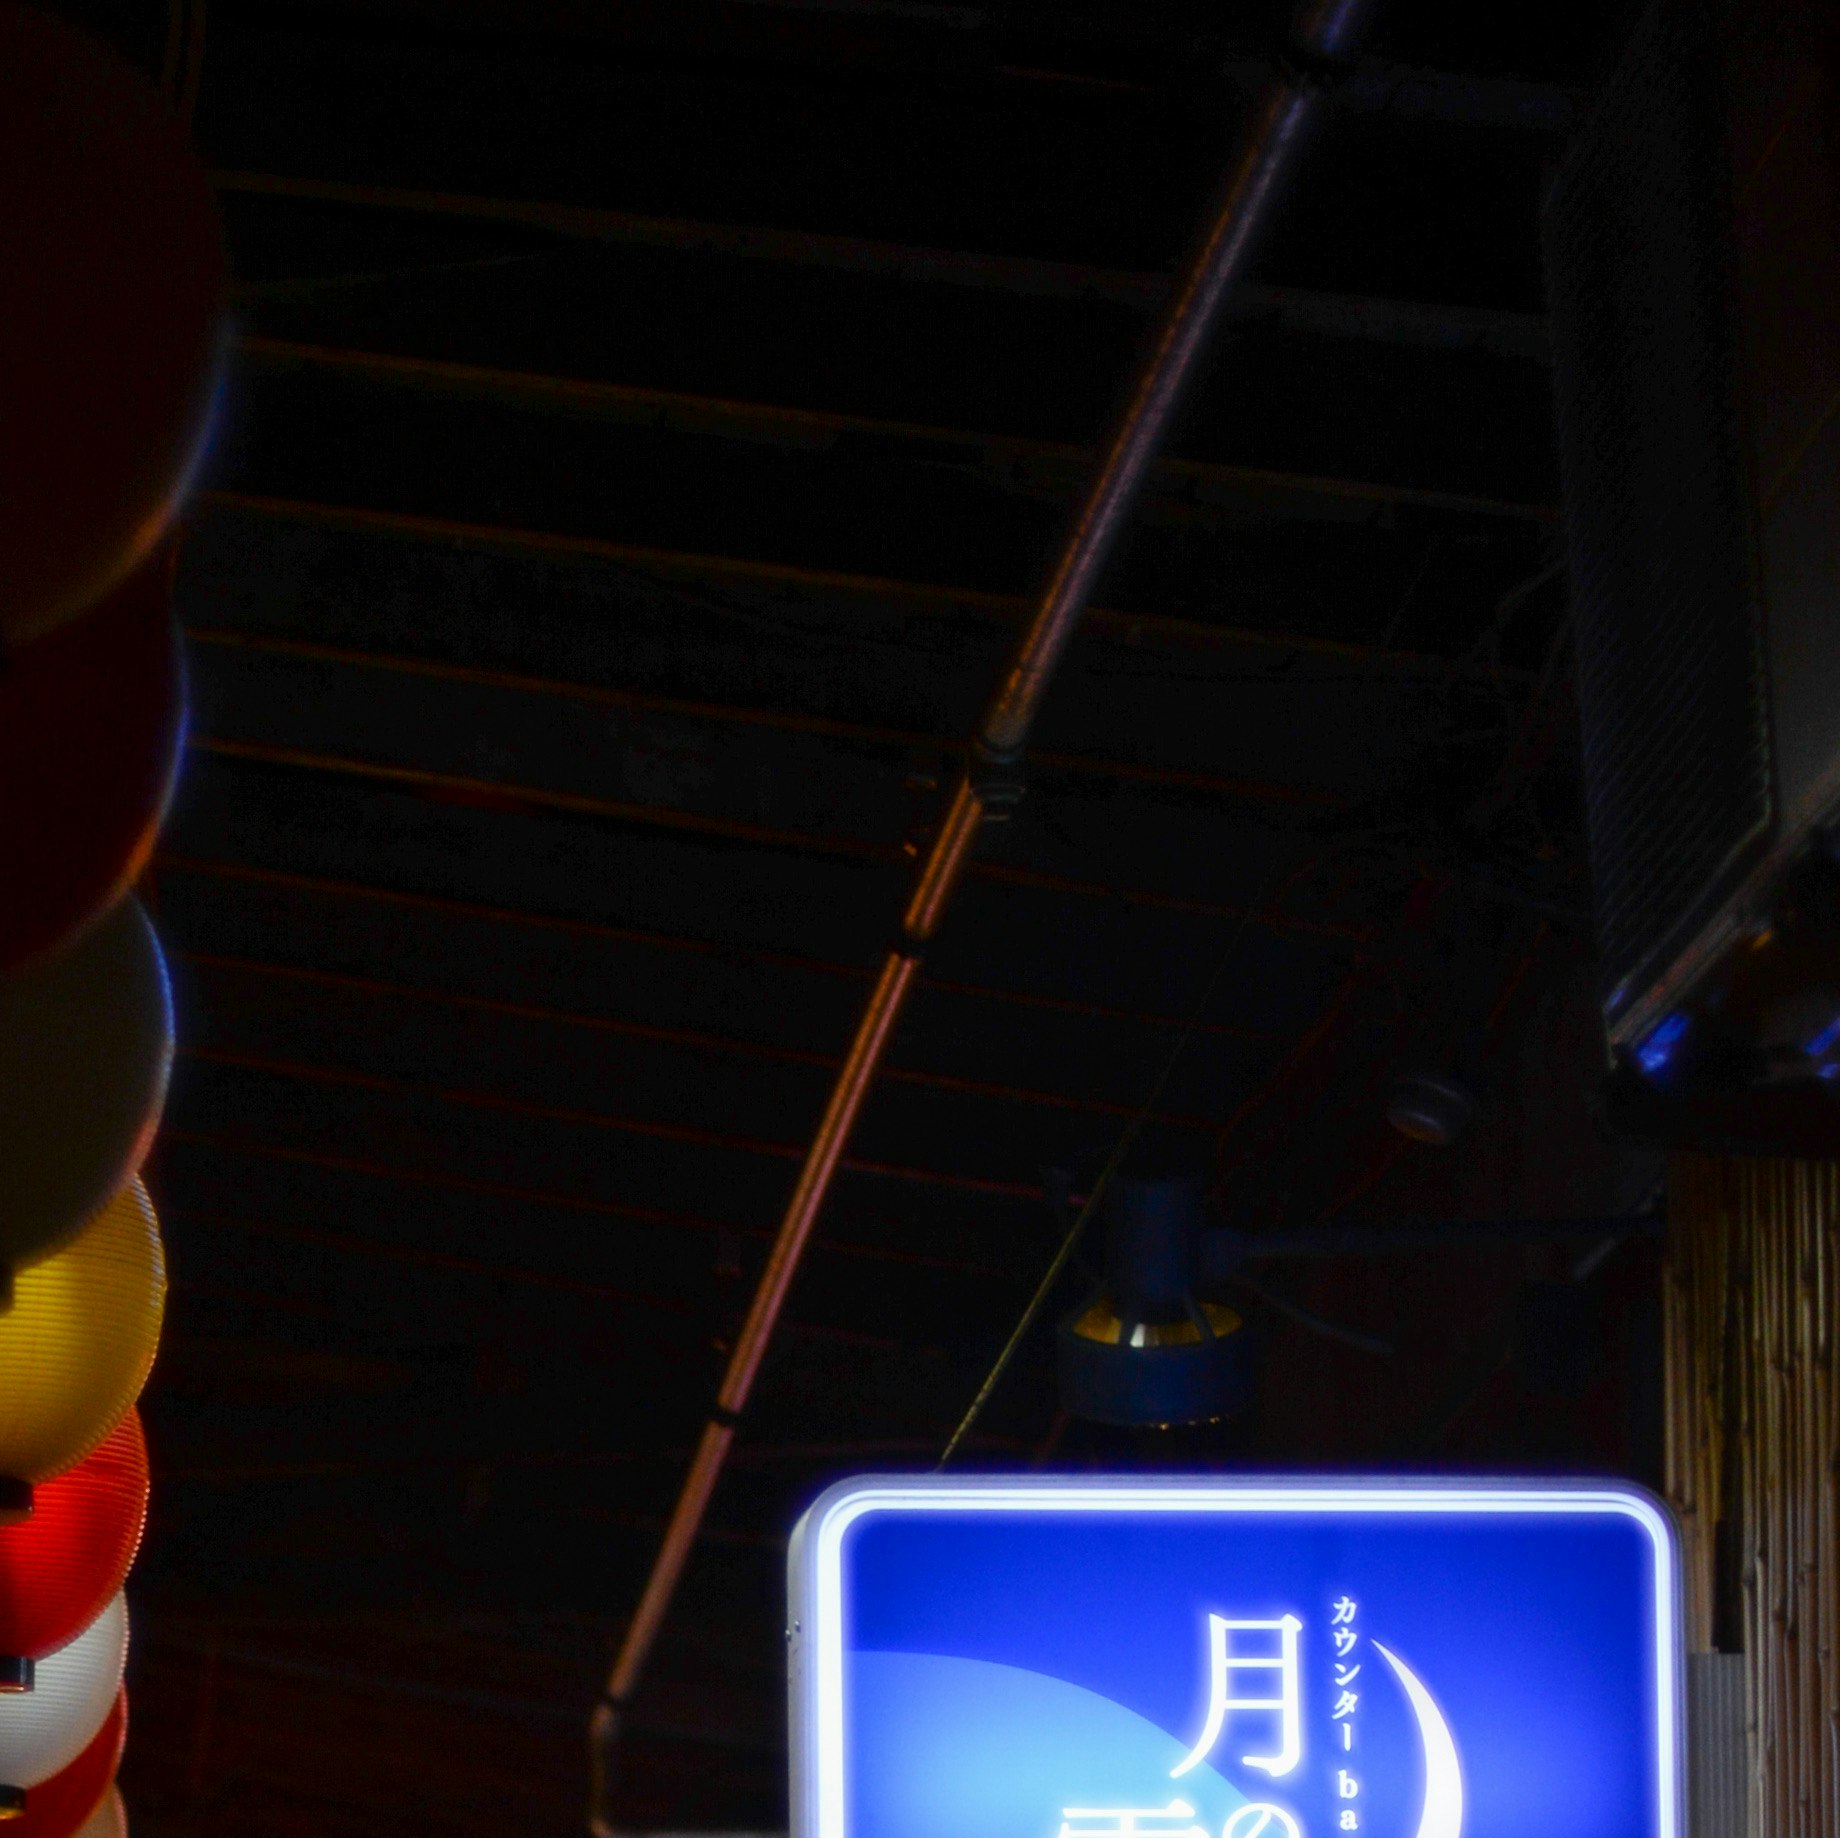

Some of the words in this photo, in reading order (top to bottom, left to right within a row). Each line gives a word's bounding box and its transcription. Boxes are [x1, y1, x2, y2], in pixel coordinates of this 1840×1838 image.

[1332, 1596, 1358, 1752] カウンター
